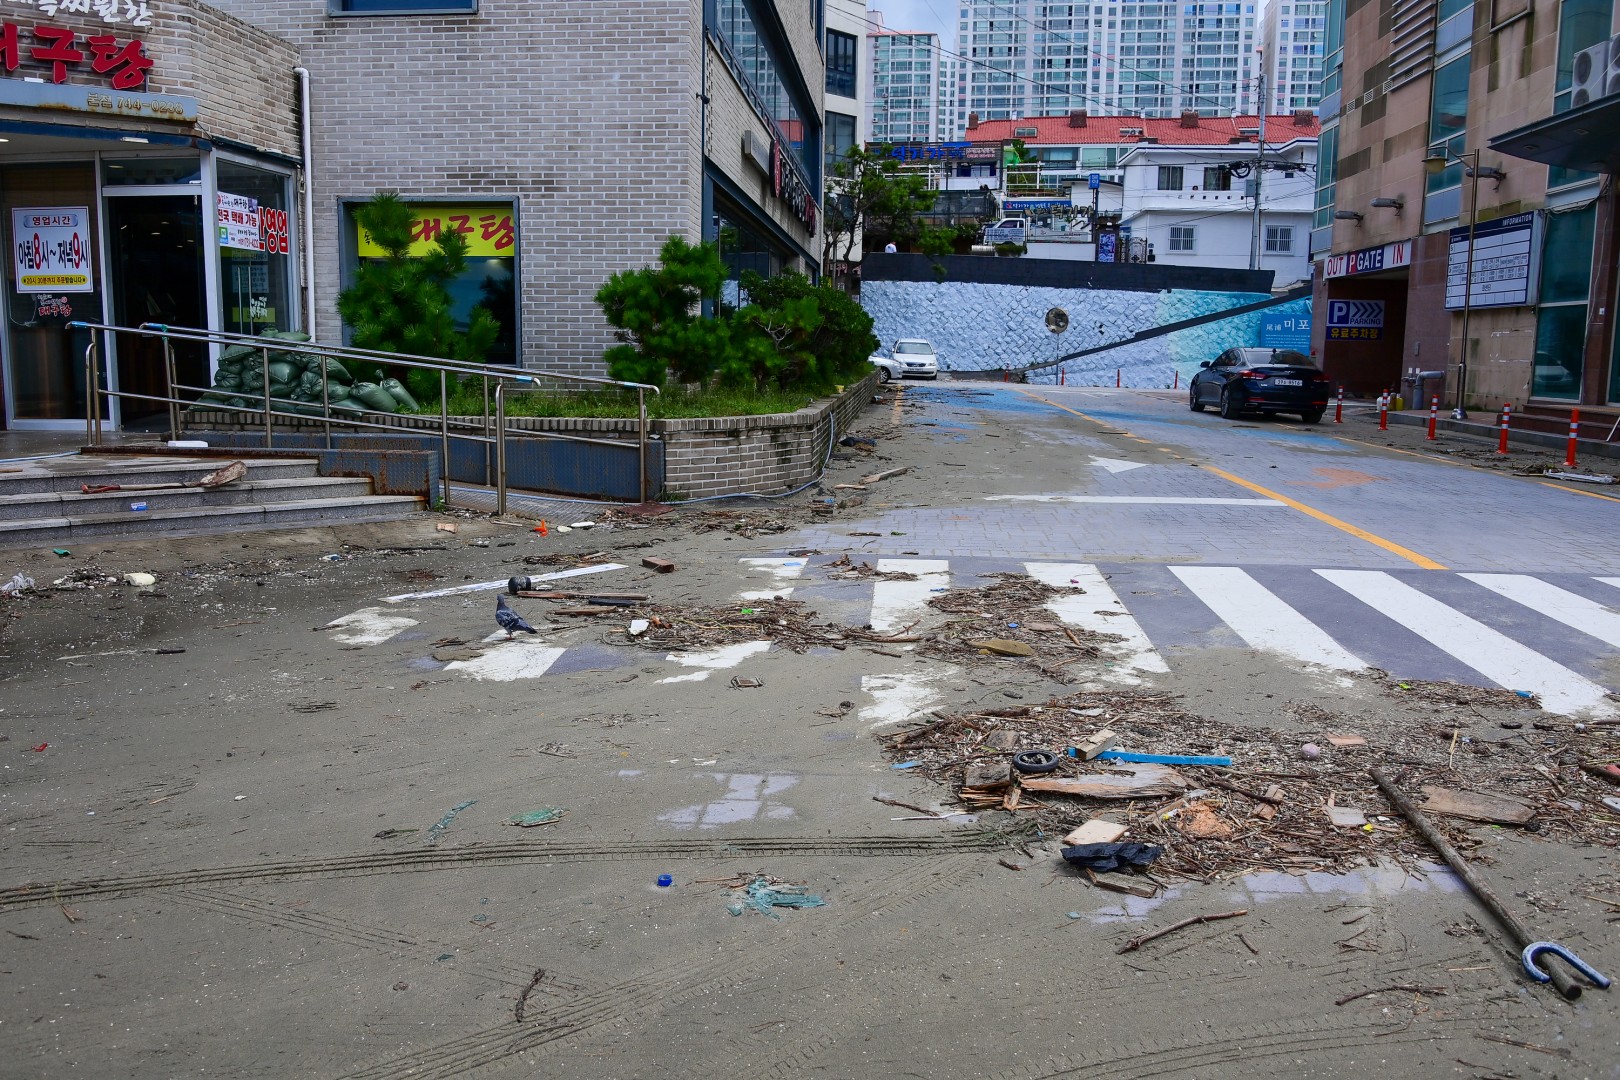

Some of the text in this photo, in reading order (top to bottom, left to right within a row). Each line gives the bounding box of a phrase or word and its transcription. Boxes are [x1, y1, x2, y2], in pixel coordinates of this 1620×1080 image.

[32, 216, 71, 226] 영업시간
[246, 213, 257, 227] 가능
[1502, 214, 1532, 226] INFORMATION
[1327, 243, 1404, 276] OUT P GATE IN
[1333, 302, 1347, 323] P
[1284, 317, 1311, 332] 미포
[1331, 327, 1378, 339] 유료주차장
